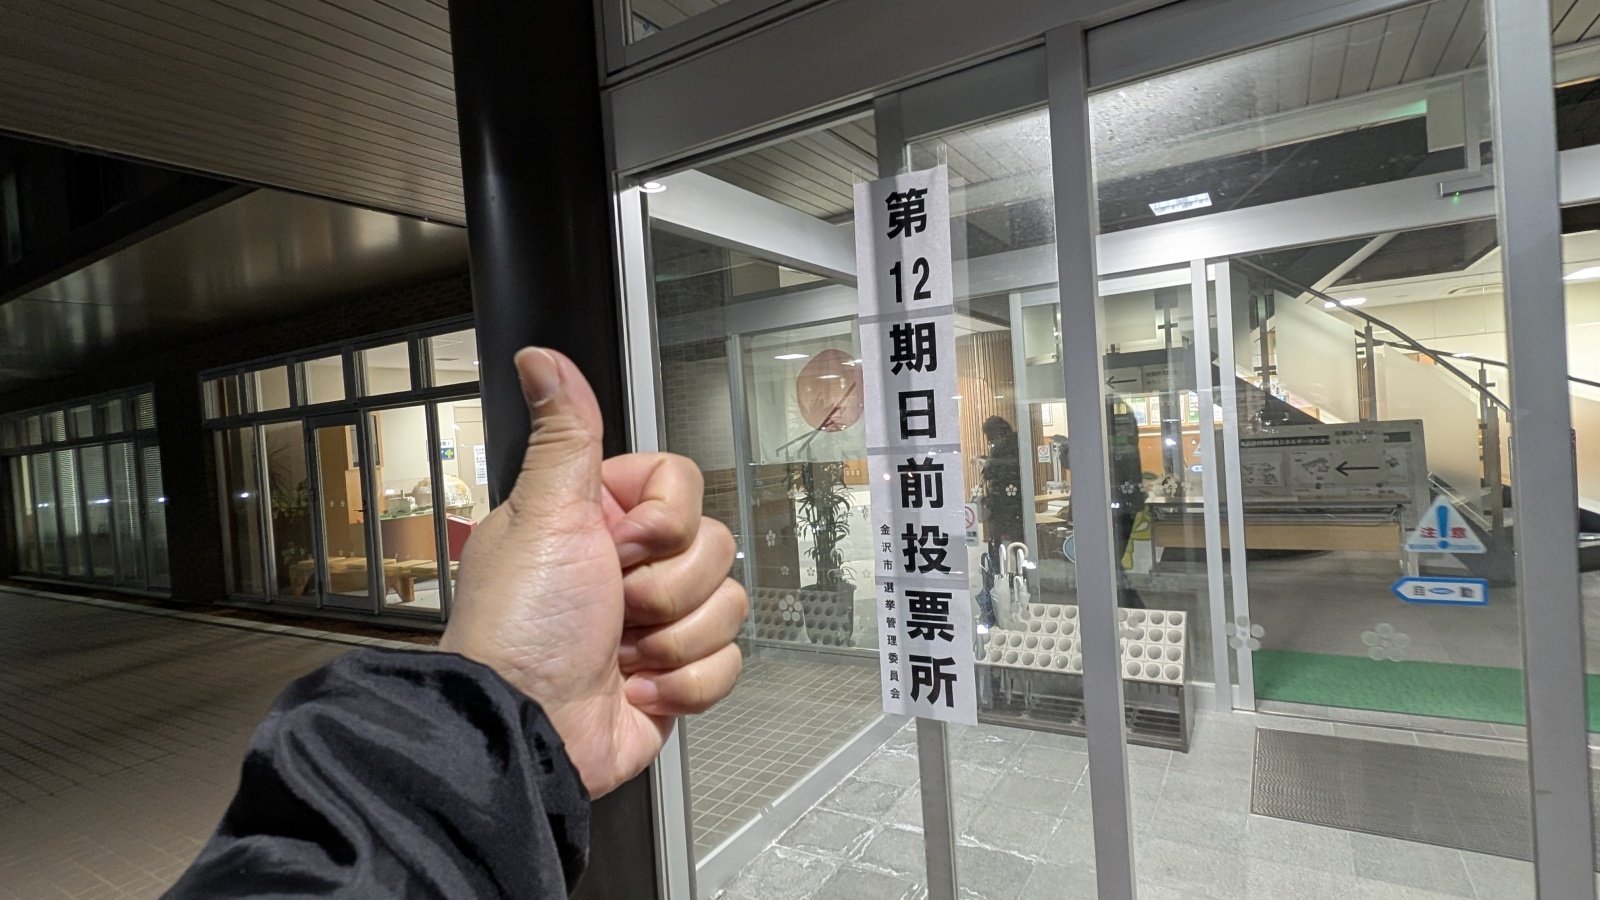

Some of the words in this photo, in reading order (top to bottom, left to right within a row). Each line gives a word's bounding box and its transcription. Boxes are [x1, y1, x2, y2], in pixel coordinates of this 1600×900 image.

[880, 523, 901, 700] 金沢市選挙管理委員会
[885, 188, 957, 708] 第12期日前投票所
